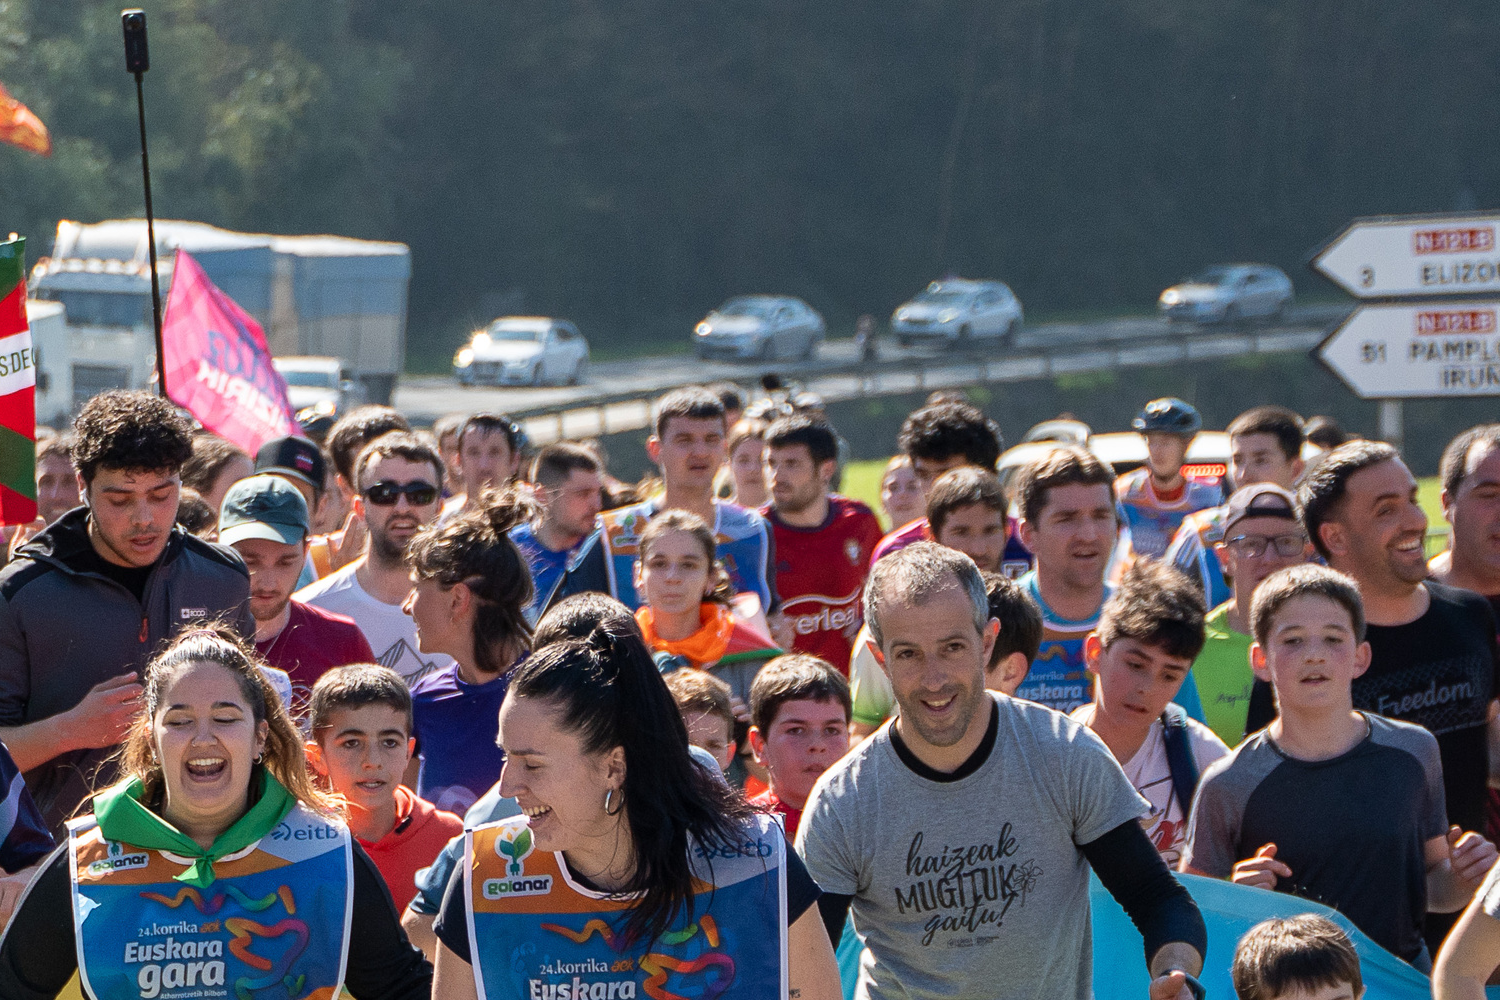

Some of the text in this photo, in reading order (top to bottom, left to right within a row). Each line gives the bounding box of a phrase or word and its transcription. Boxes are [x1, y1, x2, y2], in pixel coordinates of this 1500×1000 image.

[1422, 263, 1500, 286] ELIZO
[1411, 340, 1500, 361] PAMPL
[1017, 682, 1083, 701] uskara
[1378, 678, 1475, 716] Freedom
[294, 823, 339, 841] eitb
[906, 822, 1020, 878] haizeak
[895, 864, 1019, 914] MUGITUK
[138, 920, 198, 938] 24.korrika
[124, 937, 223, 963] Euskara
[539, 957, 635, 975] 24.korrika aek
[138, 961, 225, 999] gara
